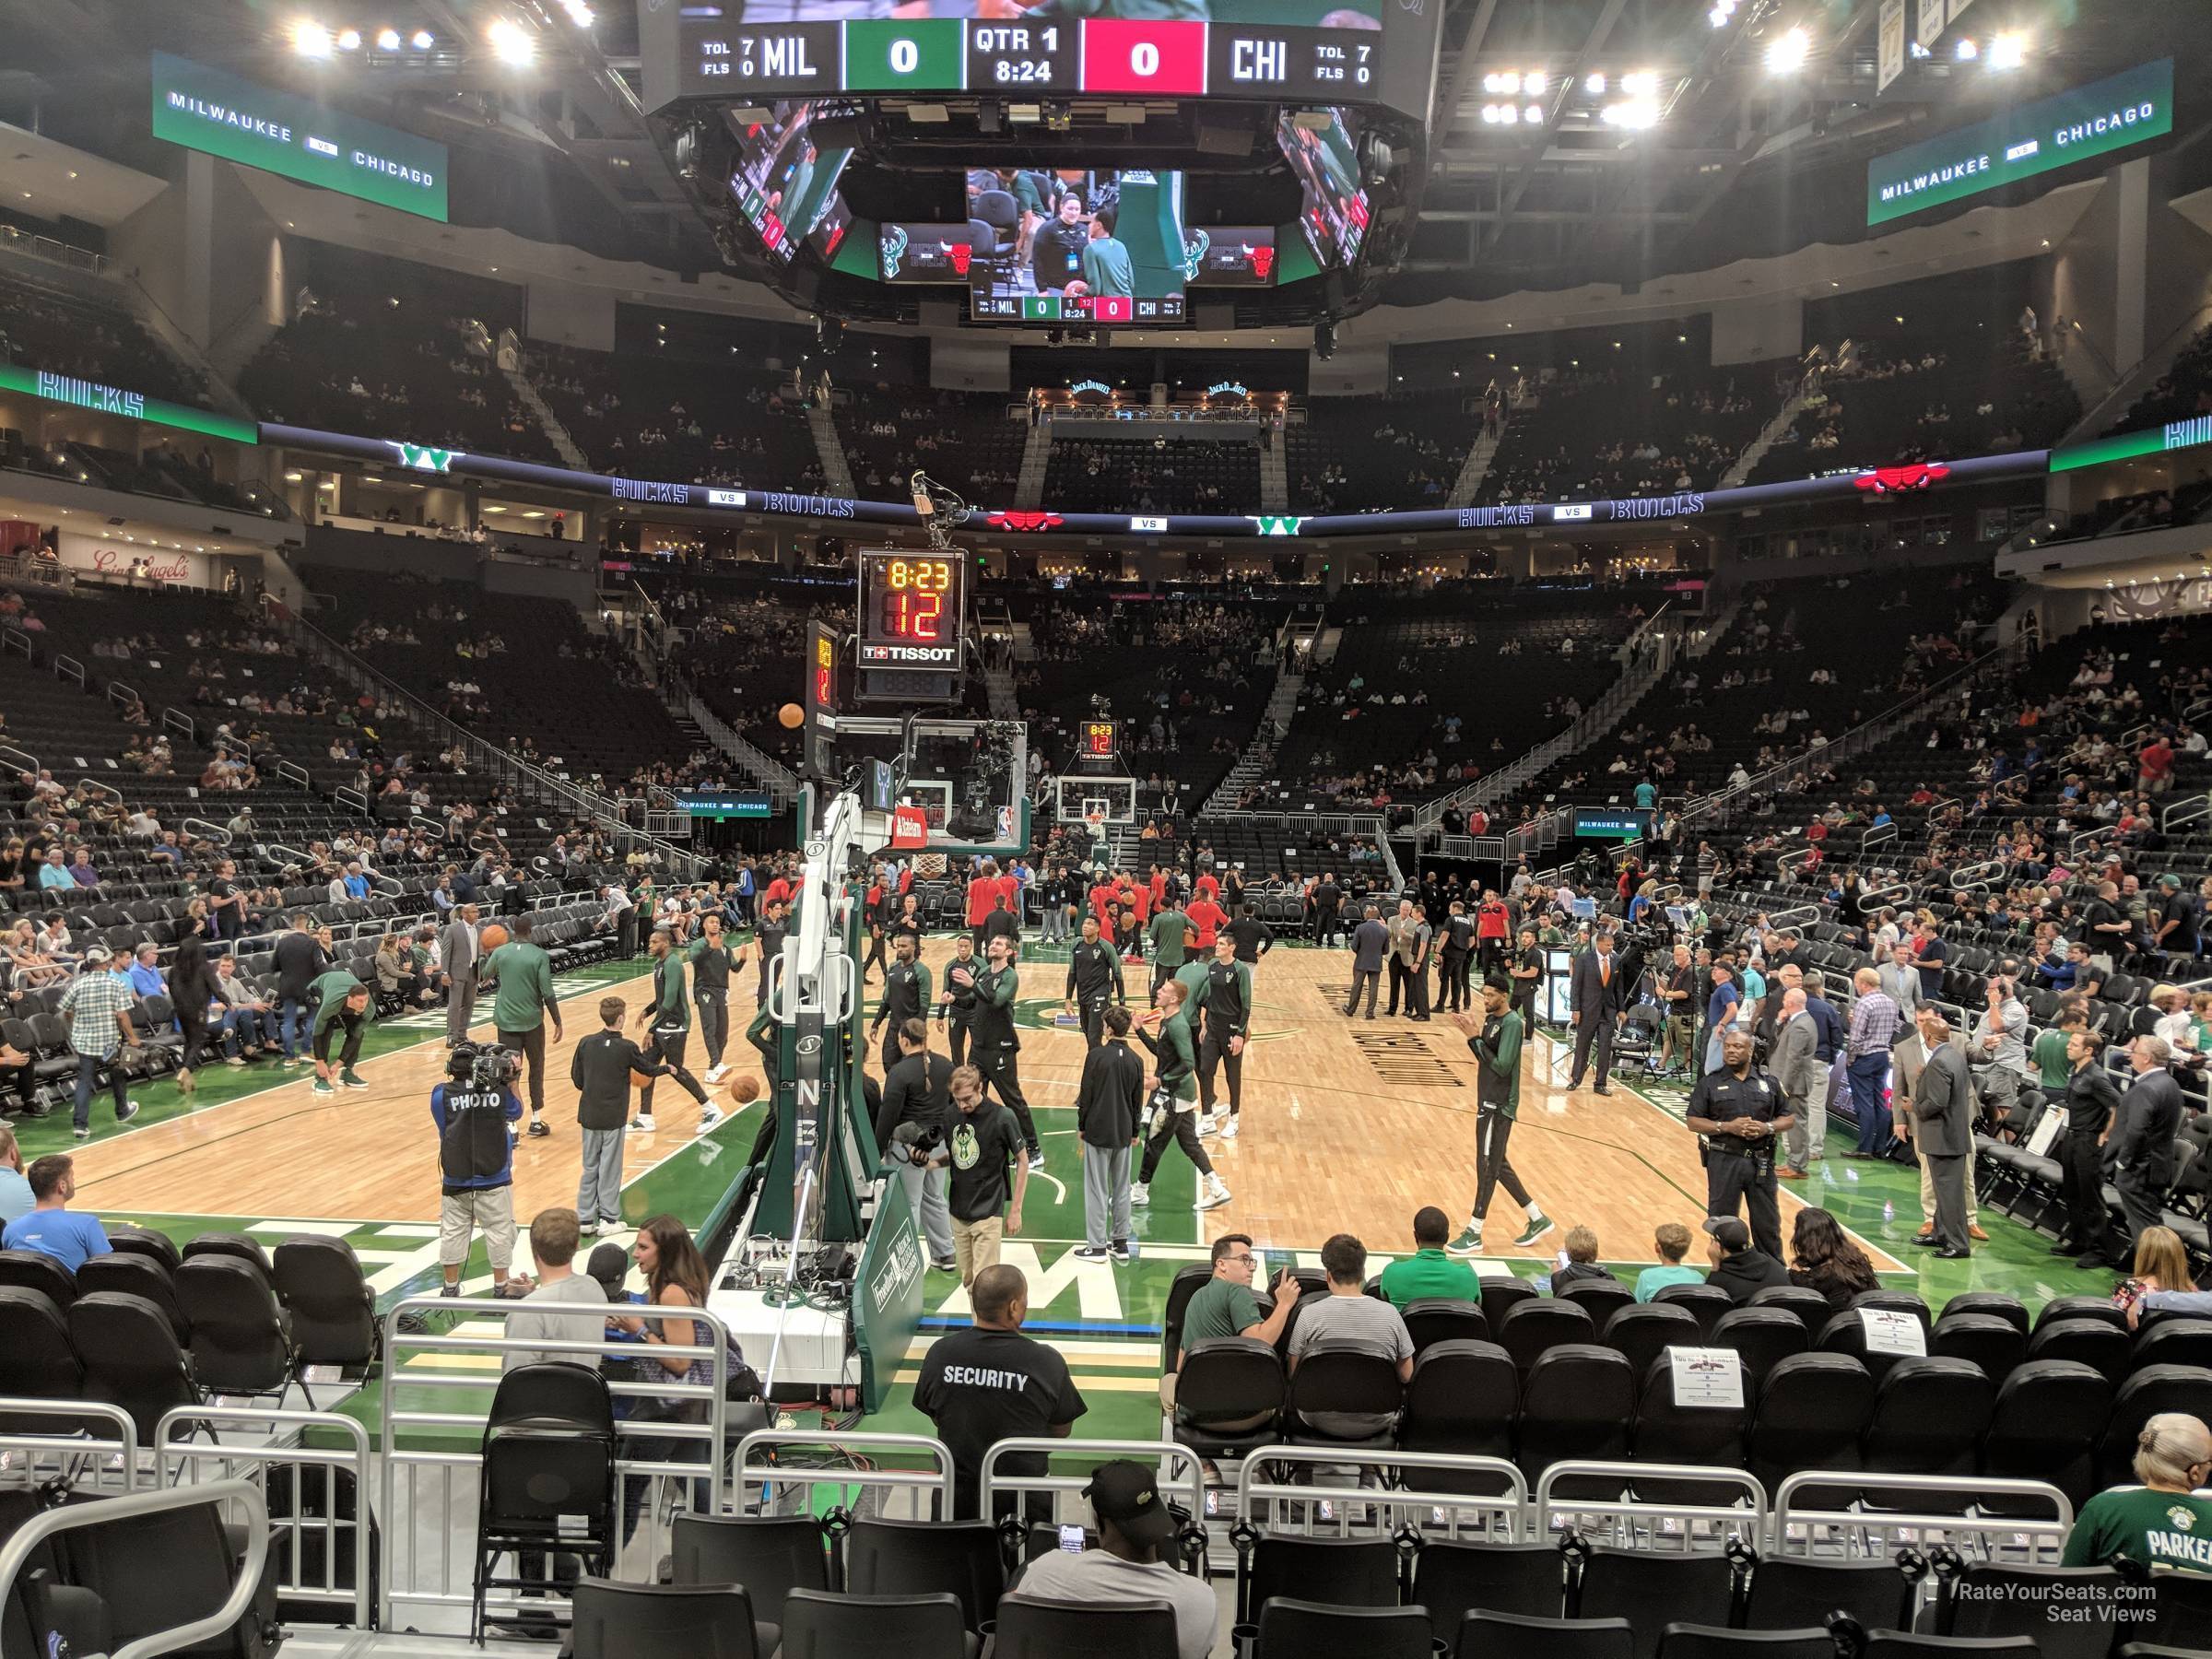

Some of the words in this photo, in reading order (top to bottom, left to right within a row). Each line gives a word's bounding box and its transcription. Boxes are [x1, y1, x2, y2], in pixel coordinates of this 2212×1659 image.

[704, 43, 730, 54] TOL
[742, 40, 754, 55] 7
[976, 28, 1030, 52] QTR
[1041, 28, 1058, 51] 1
[763, 38, 817, 76] MIL
[889, 40, 918, 73] 0
[1130, 42, 1159, 76] 0
[1232, 40, 1287, 80] CHI
[1317, 46, 1345, 59] TOL
[1358, 44, 1371, 63] 7
[704, 63, 729, 75] FLS
[742, 61, 754, 76] 0
[995, 60, 1053, 82] 8:24
[1317, 66, 1343, 79] FLS
[1358, 66, 1370, 83] 0
[170, 91, 292, 142] MILWAUKEE
[356, 151, 433, 187] CHICAGO
[1881, 155, 1991, 201] MILWAUKEE
[2056, 103, 2153, 145] CHICAGO
[998, 300, 1016, 314] MIL
[1038, 300, 1047, 315] 0
[1065, 310, 1086, 319] 8:24
[1109, 301, 1118, 316] 0
[1139, 302, 1157, 315] CHI
[1072, 382, 1088, 394] JACK
[1208, 382, 1224, 396] JACK
[612, 477, 688, 504] BUCKS
[720, 493, 735, 502] VS
[763, 491, 855, 519] BULLS
[1458, 505, 1535, 528] BUCKS
[1565, 508, 1581, 516] VS
[1609, 493, 1705, 521] BULLS
[1142, 518, 1158, 528] VS
[891, 561, 949, 589] 8:23
[900, 592, 941, 637] 12
[888, 647, 955, 661] TISSOT
[1090, 725, 1112, 735] 8:23
[1094, 735, 1109, 751] 12
[450, 1093, 500, 1112] PHOTO
[943, 1365, 1029, 1392] SECURITY
